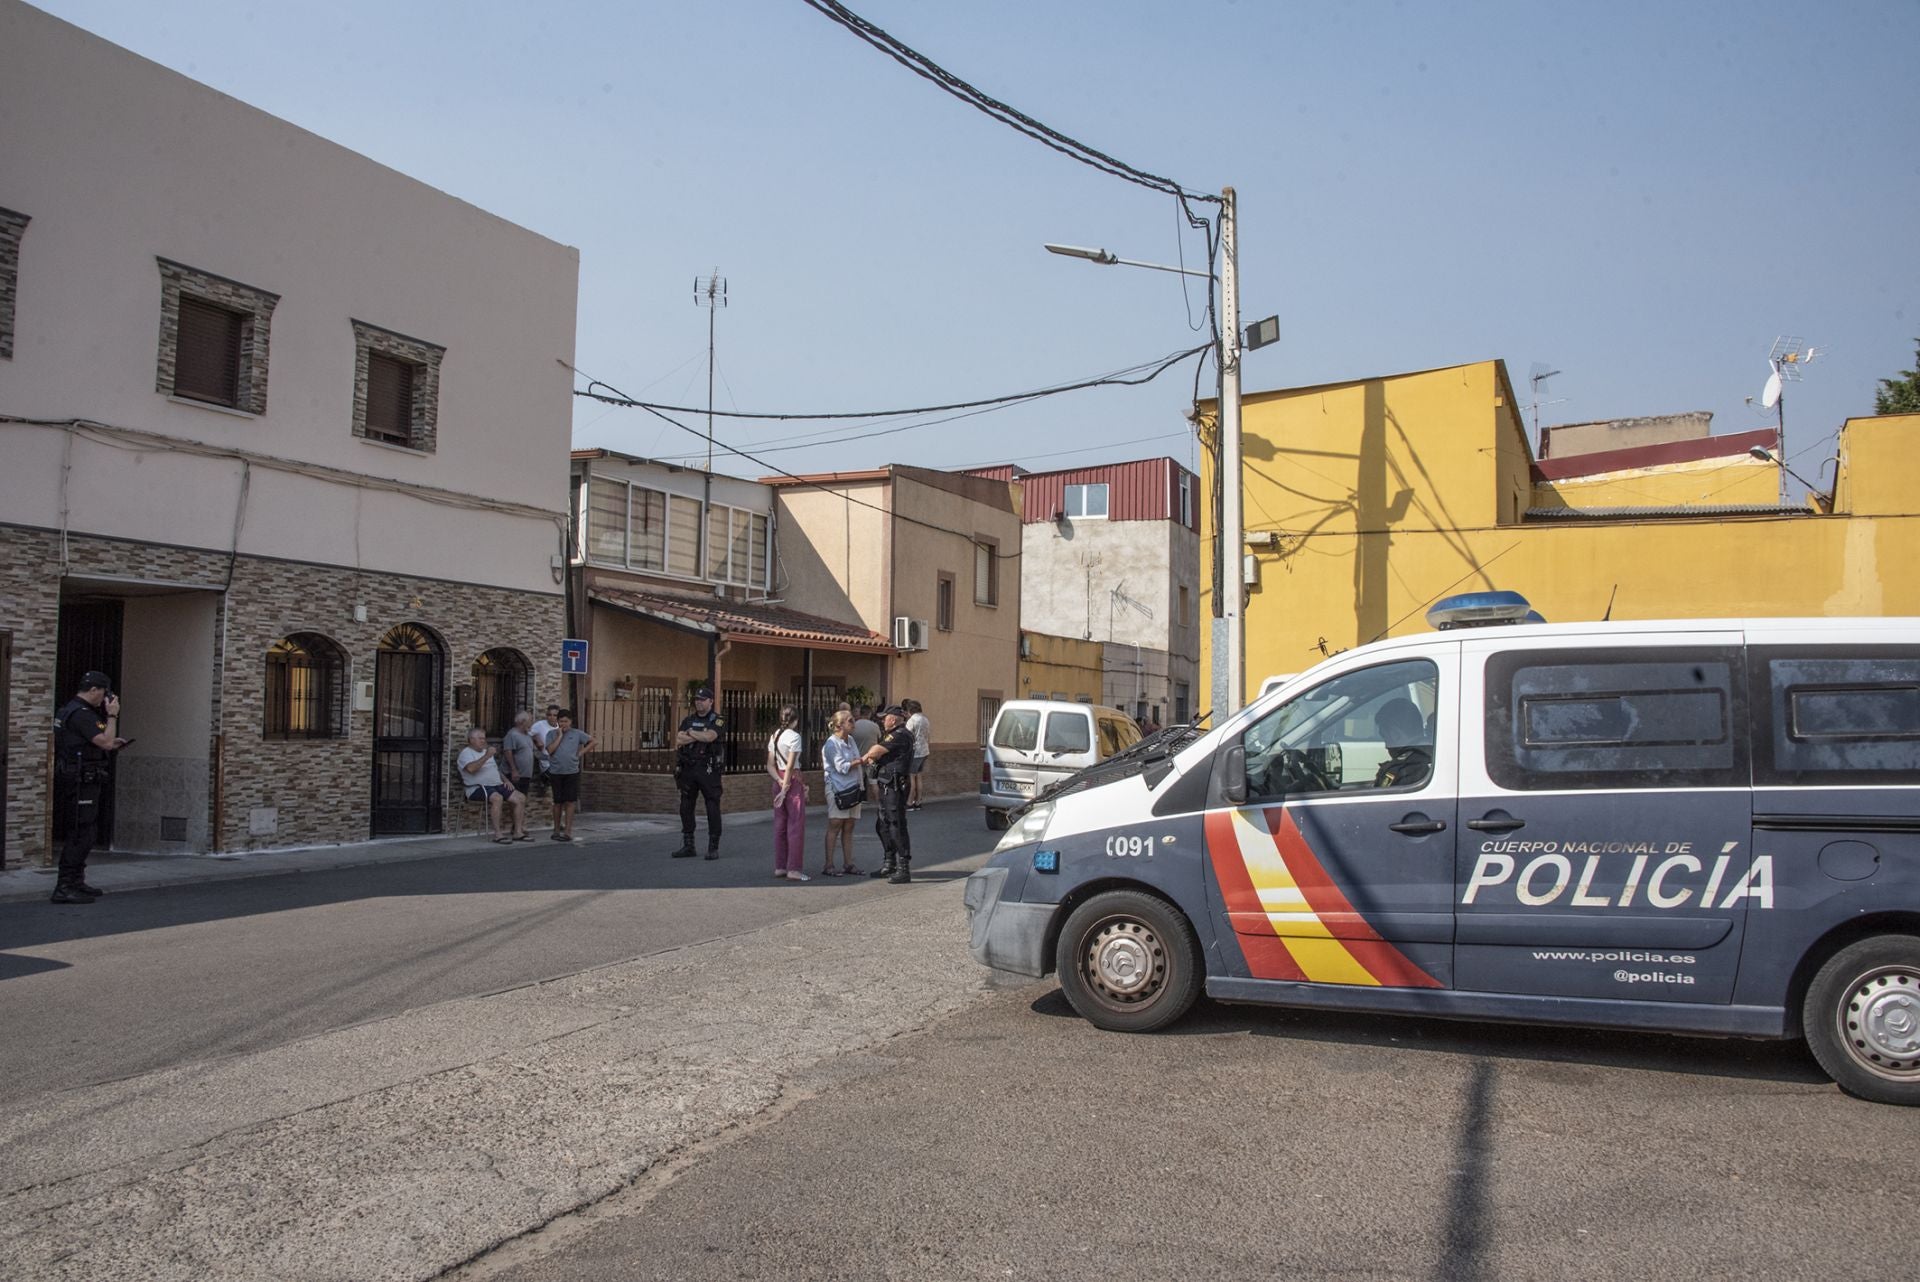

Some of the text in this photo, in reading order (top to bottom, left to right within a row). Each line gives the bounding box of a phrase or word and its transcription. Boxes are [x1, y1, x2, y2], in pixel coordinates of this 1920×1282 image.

[1115, 836, 1154, 857] 091
[1481, 841, 1693, 854] CUERPO NACIONAL DE
[1461, 841, 1774, 909] POLICÍA
[1532, 951, 1696, 964] www.policia.es
[1613, 969, 1695, 985] @policia
